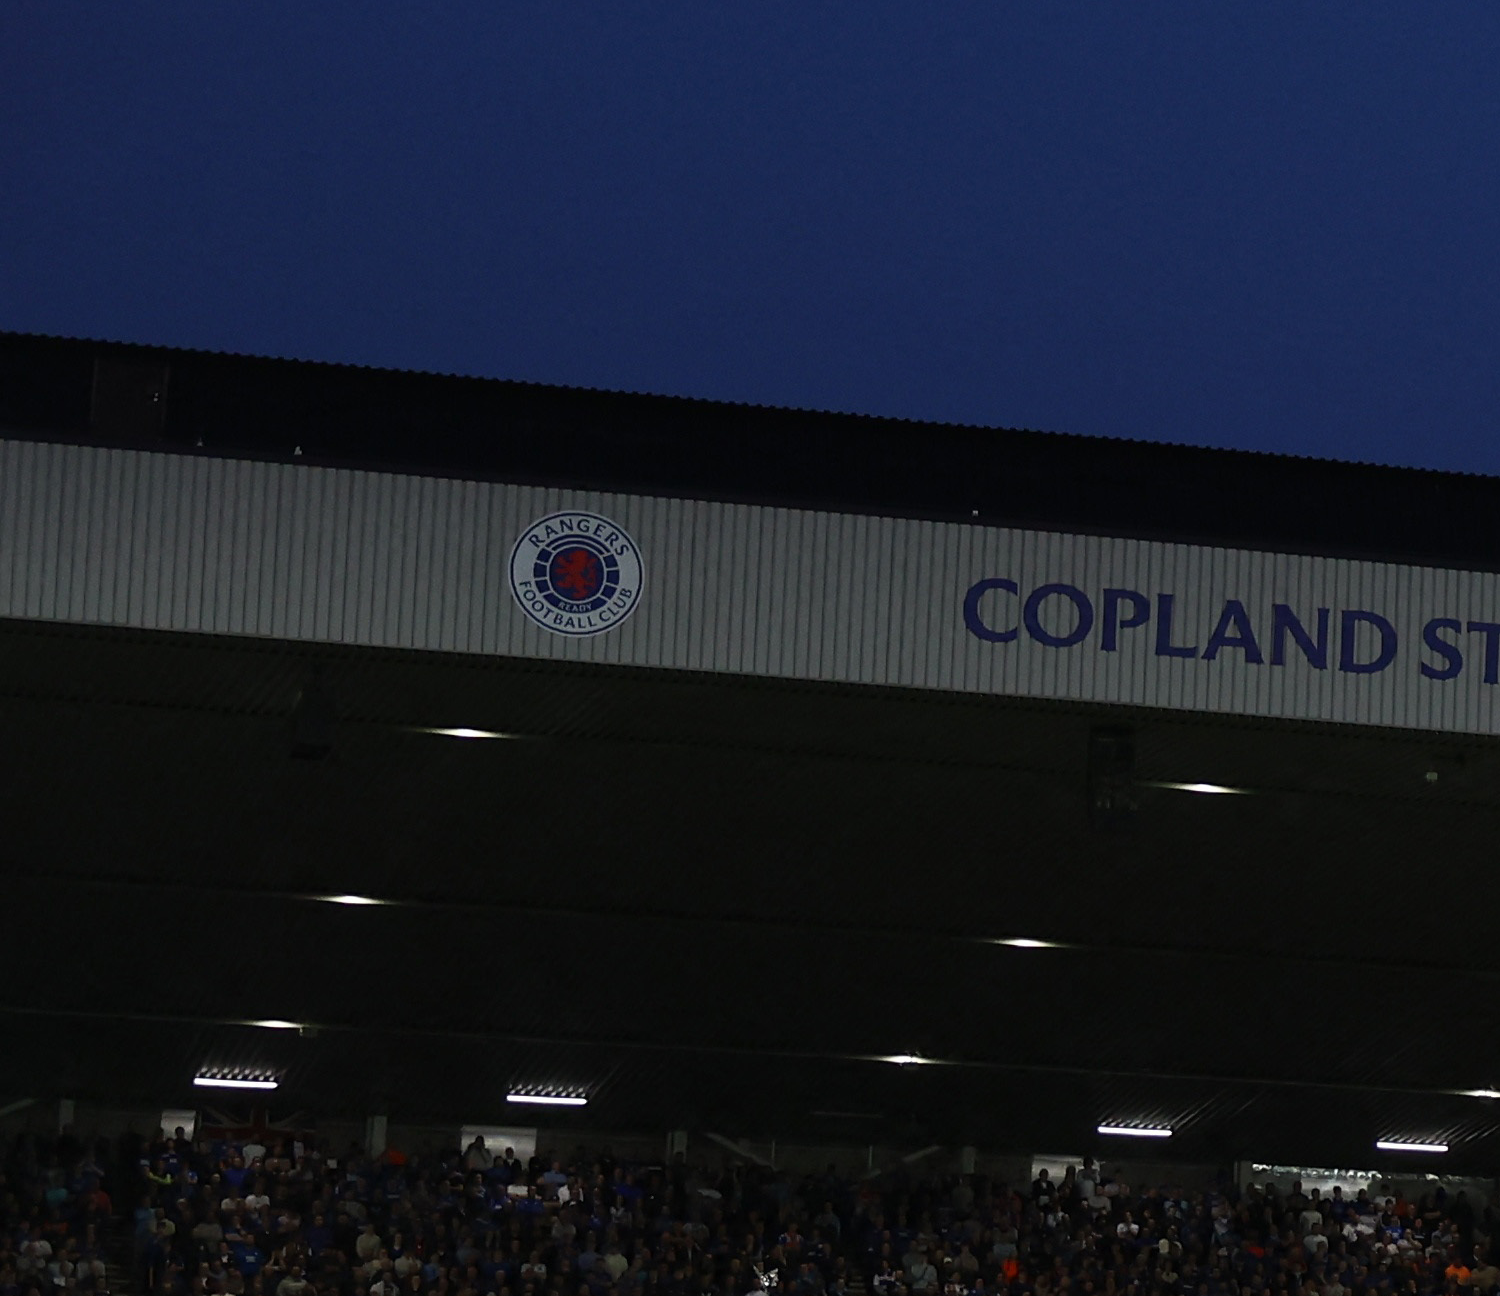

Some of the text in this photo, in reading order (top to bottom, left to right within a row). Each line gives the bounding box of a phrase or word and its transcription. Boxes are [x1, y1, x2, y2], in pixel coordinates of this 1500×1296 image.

[528, 518, 629, 556] RANGERS
[519, 580, 633, 629] FOOTBALL CLUB
[557, 602, 592, 613] READY
[962, 577, 1398, 676] COPLAND
